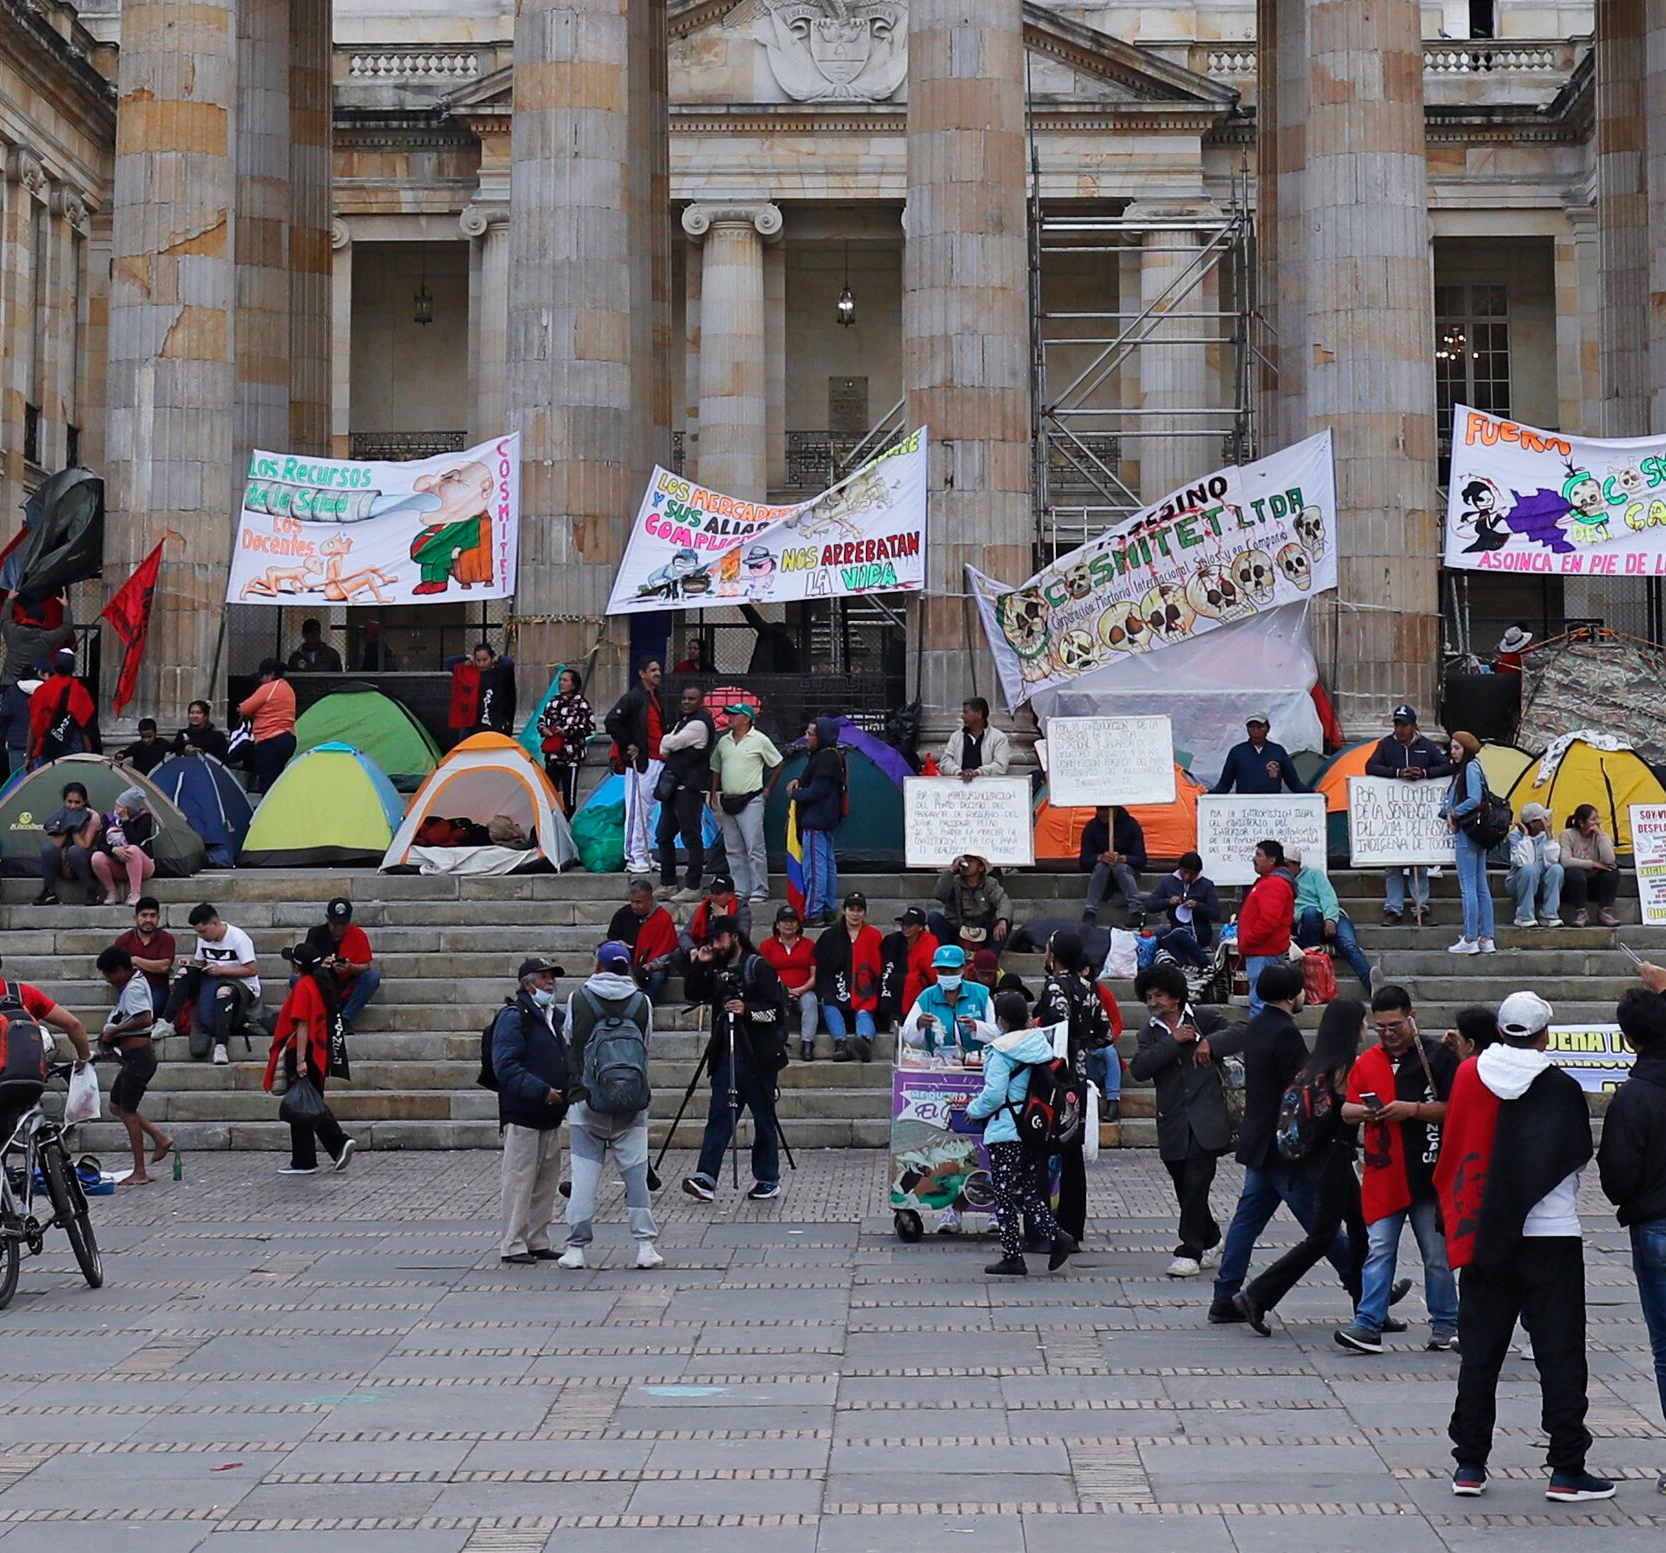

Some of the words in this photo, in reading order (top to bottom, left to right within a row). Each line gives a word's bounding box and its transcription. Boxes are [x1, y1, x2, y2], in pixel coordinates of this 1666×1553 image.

[1466, 412, 1572, 455] FUERA
[658, 473, 689, 501] LOS
[496, 438, 511, 593] COSMITET
[651, 492, 663, 508] Y
[664, 499, 703, 528] SUS
[781, 546, 819, 572] NOS
[820, 531, 920, 566] ARREBATAN
[1478, 550, 1553, 571] ASOINCA
[1561, 553, 1583, 572] EN
[1589, 554, 1619, 574] PIE
[1626, 553, 1647, 574] DE
[805, 569, 833, 595] LA
[840, 562, 897, 591] VIDA
[1356, 785, 1377, 804] POR
[1387, 785, 1398, 802] EL
[1355, 804, 1369, 820] DE
[1373, 804, 1384, 820] LA
[1387, 801, 1433, 820] SENTENCIA
[1640, 810, 1655, 820] SOY
[1357, 821, 1374, 836] DEL
[1406, 821, 1422, 836] DEL
